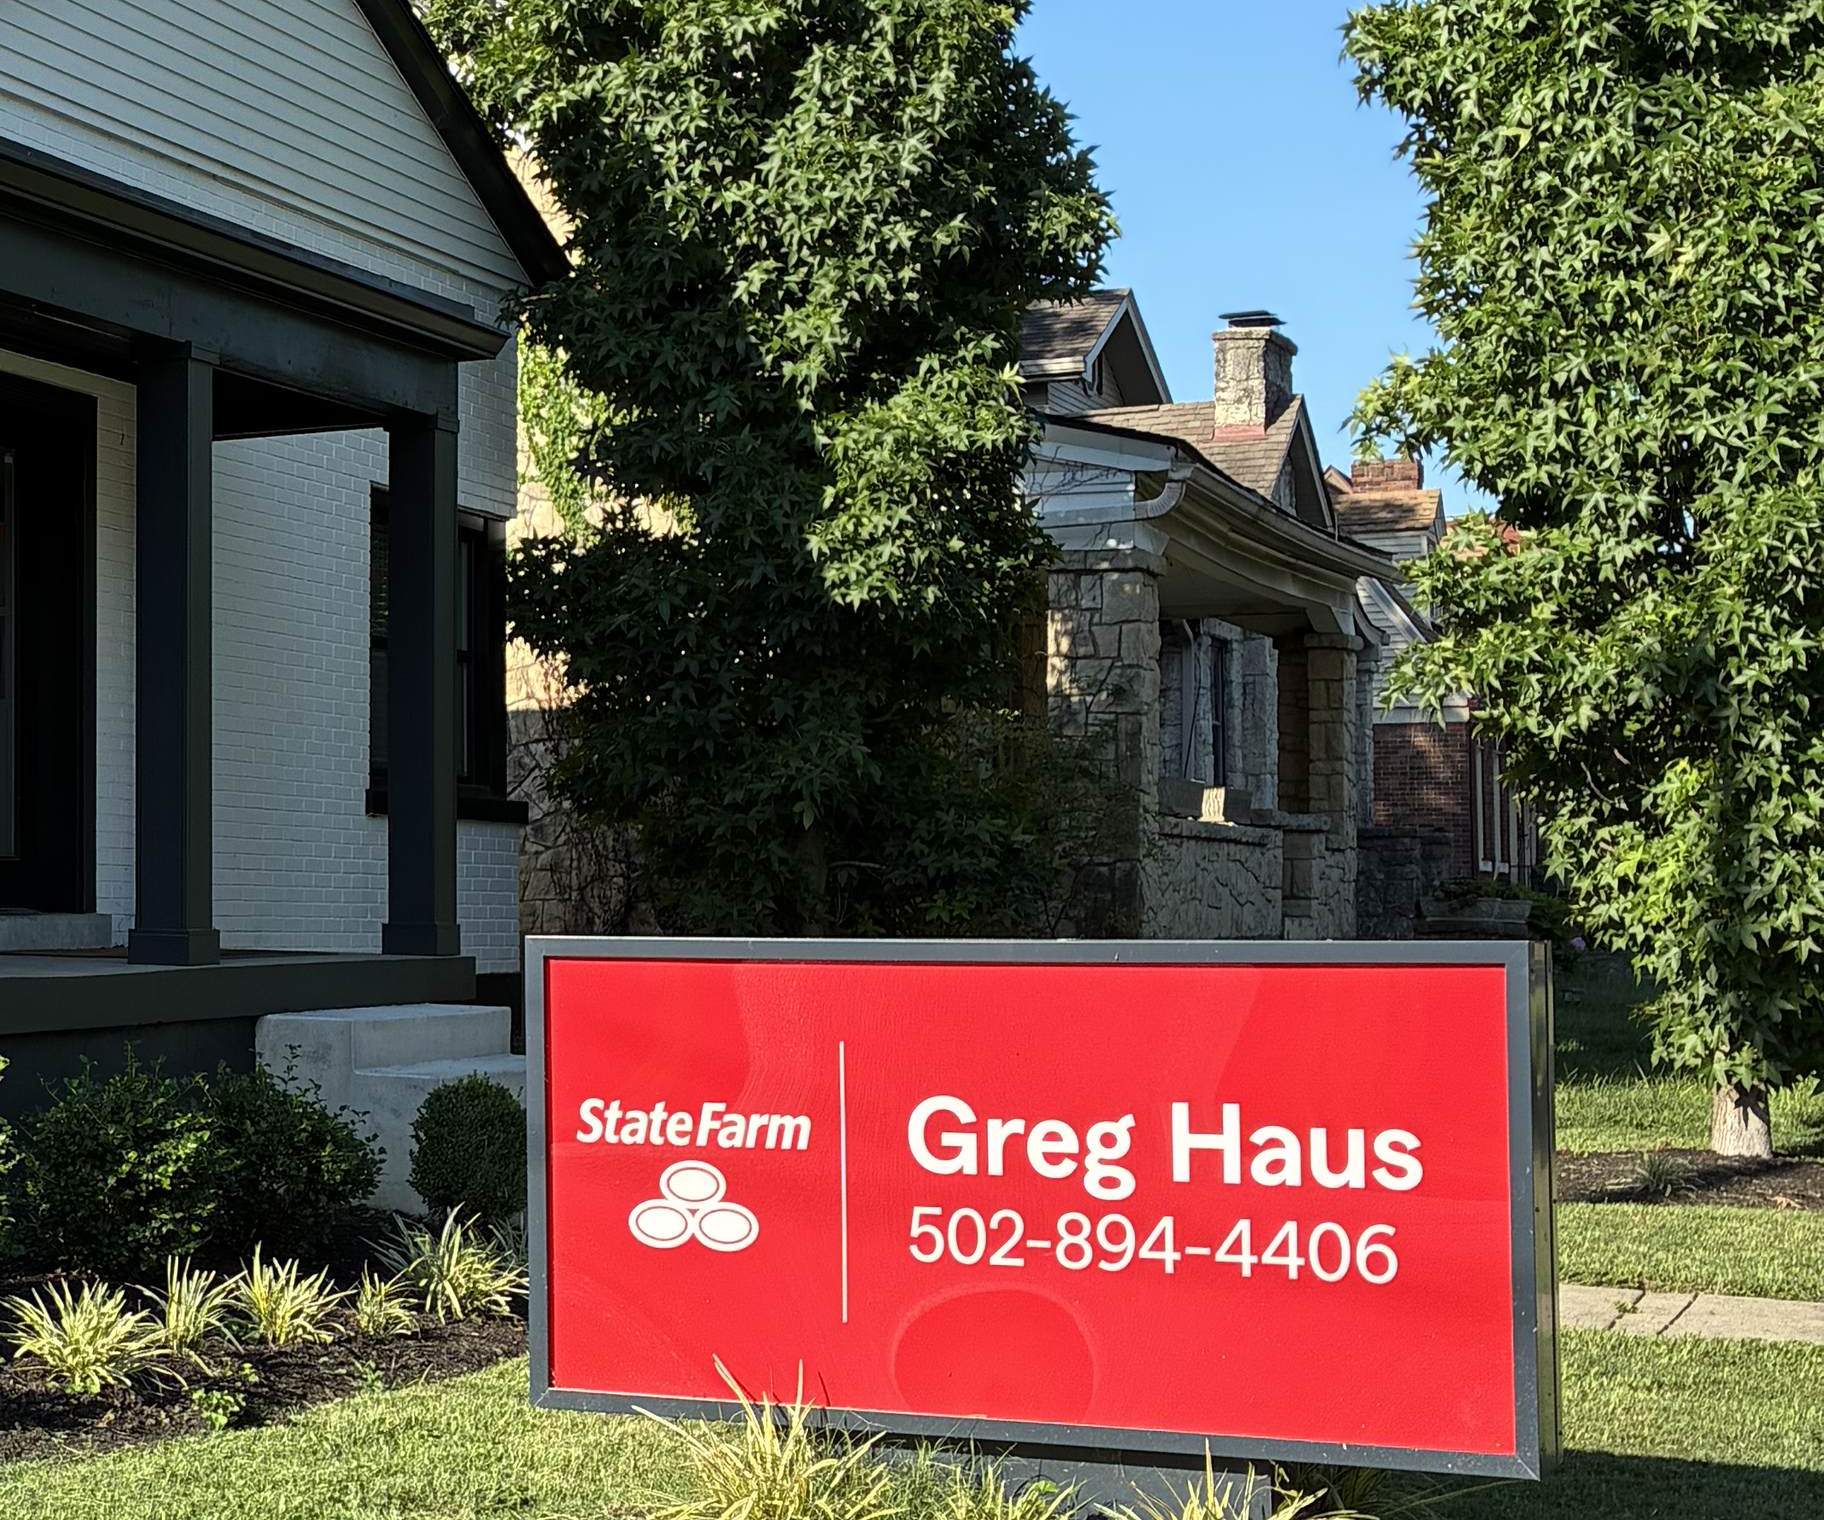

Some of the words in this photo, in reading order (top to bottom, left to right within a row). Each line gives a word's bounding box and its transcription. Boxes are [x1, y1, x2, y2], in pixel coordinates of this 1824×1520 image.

[908, 1095, 1136, 1201] Greg
[1171, 1101, 1423, 1191] Haus
[909, 1206, 1398, 1285] 502-894-4406
